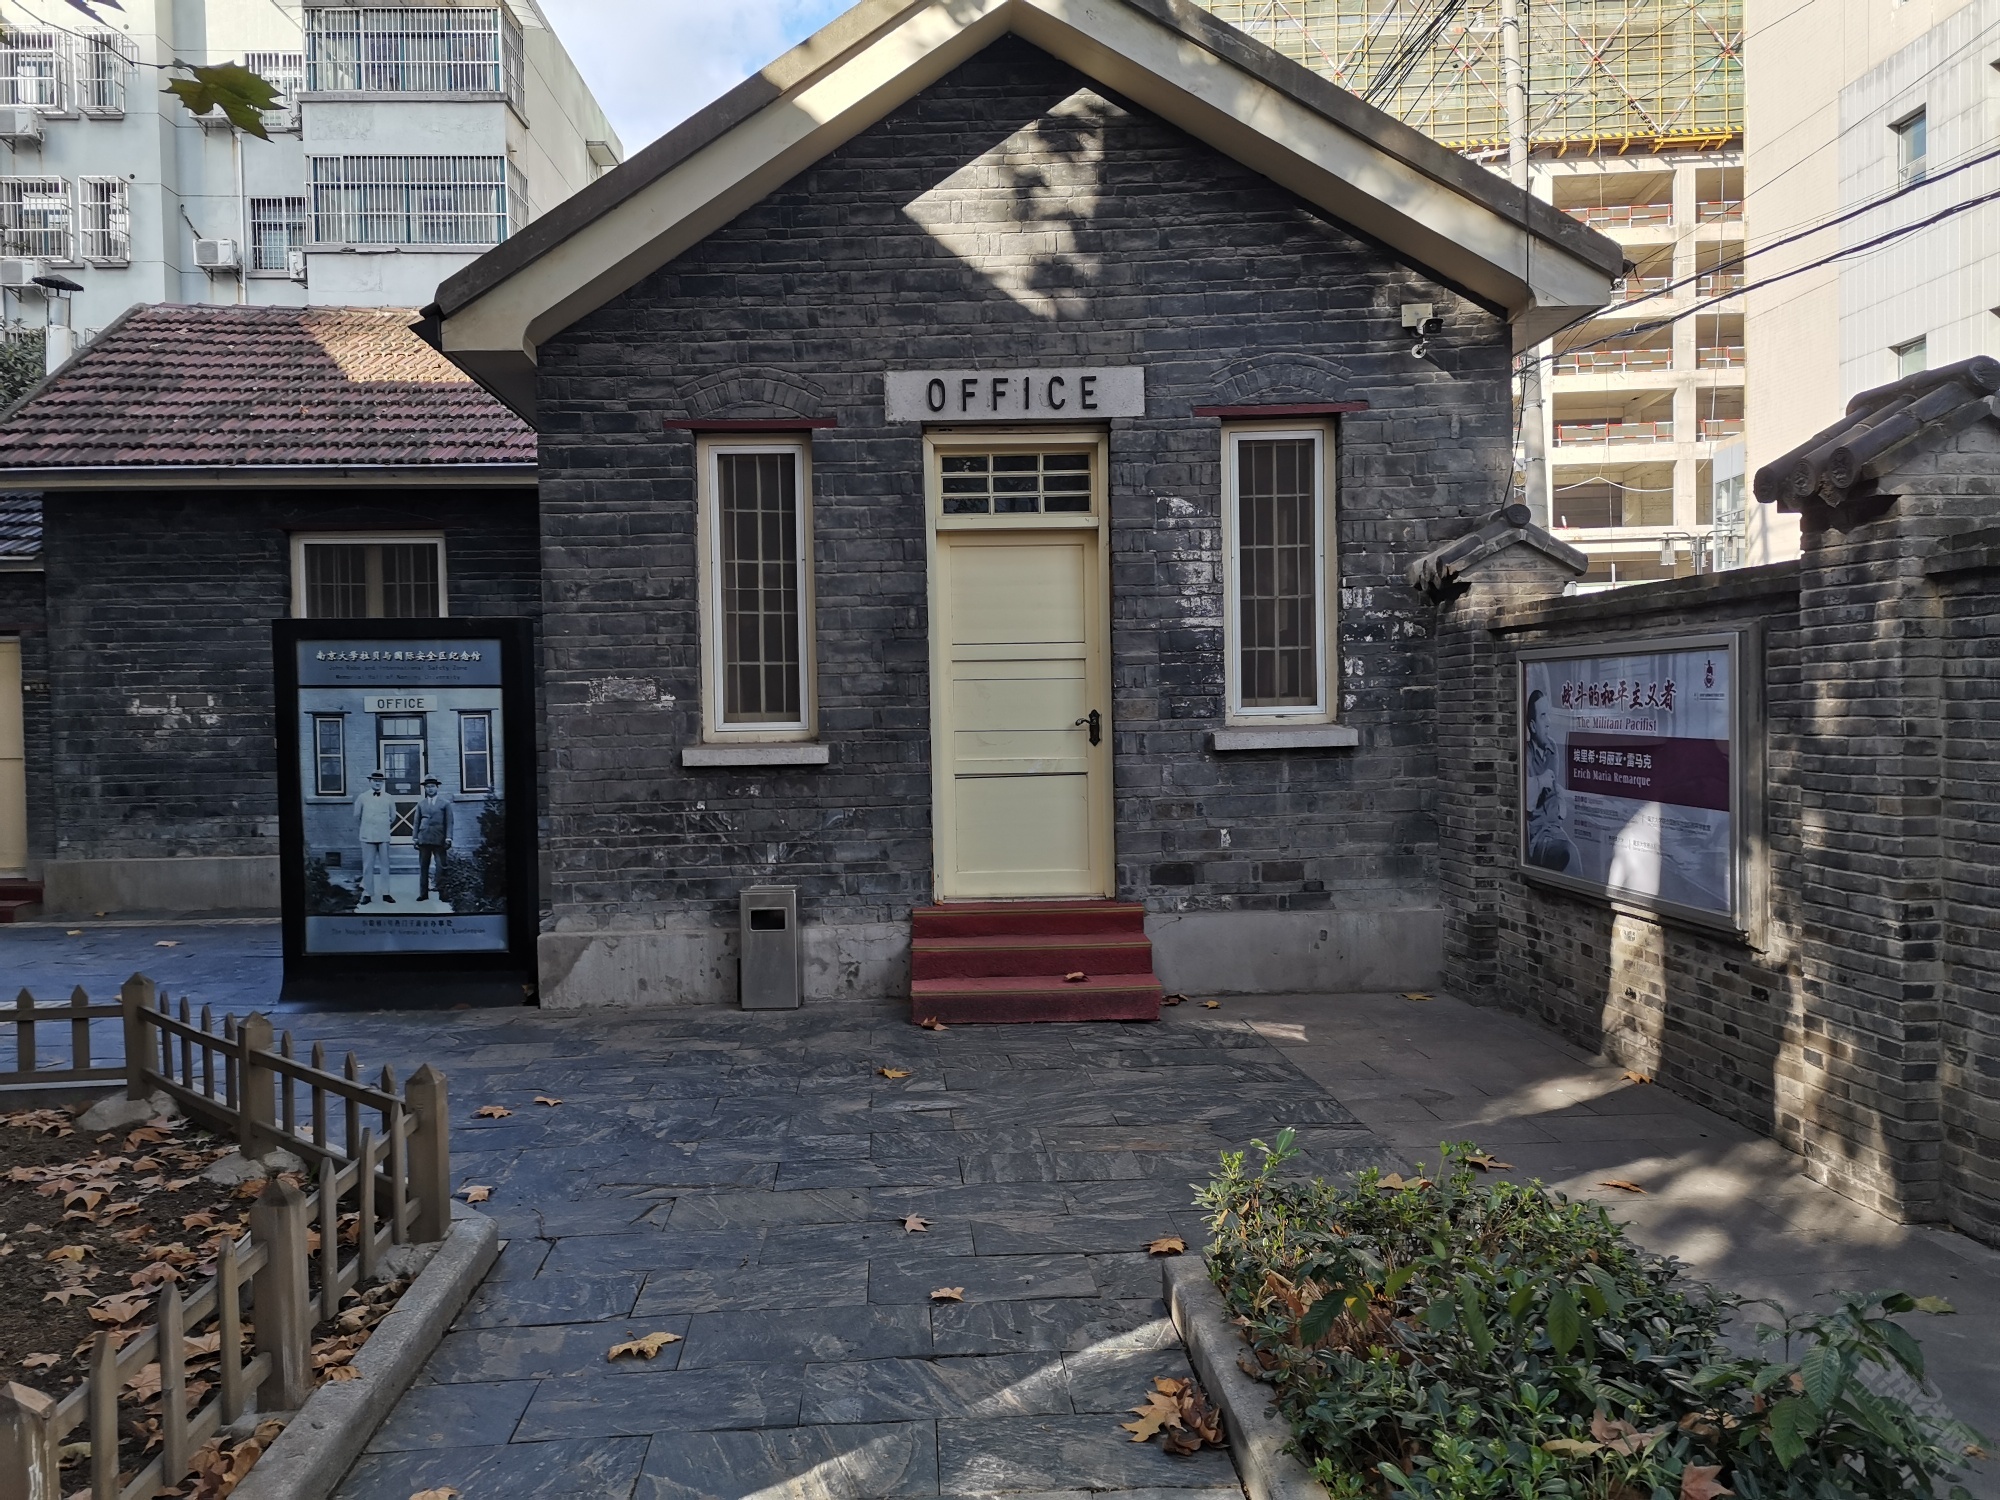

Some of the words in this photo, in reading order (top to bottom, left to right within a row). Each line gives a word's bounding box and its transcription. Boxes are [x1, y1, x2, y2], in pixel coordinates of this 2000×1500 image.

[927, 375, 1098, 412] OFFICE
[377, 697, 425, 710] OFFICE
[1561, 680, 1676, 711] 战斗的和平主义者
[1577, 716, 1590, 728] The
[1592, 717, 1622, 730] Militant
[1625, 718, 1656, 731] Pacifist
[1573, 768, 1591, 780] Erich
[1593, 769, 1612, 781] Maria
[1614, 772, 1651, 787] Remarque
